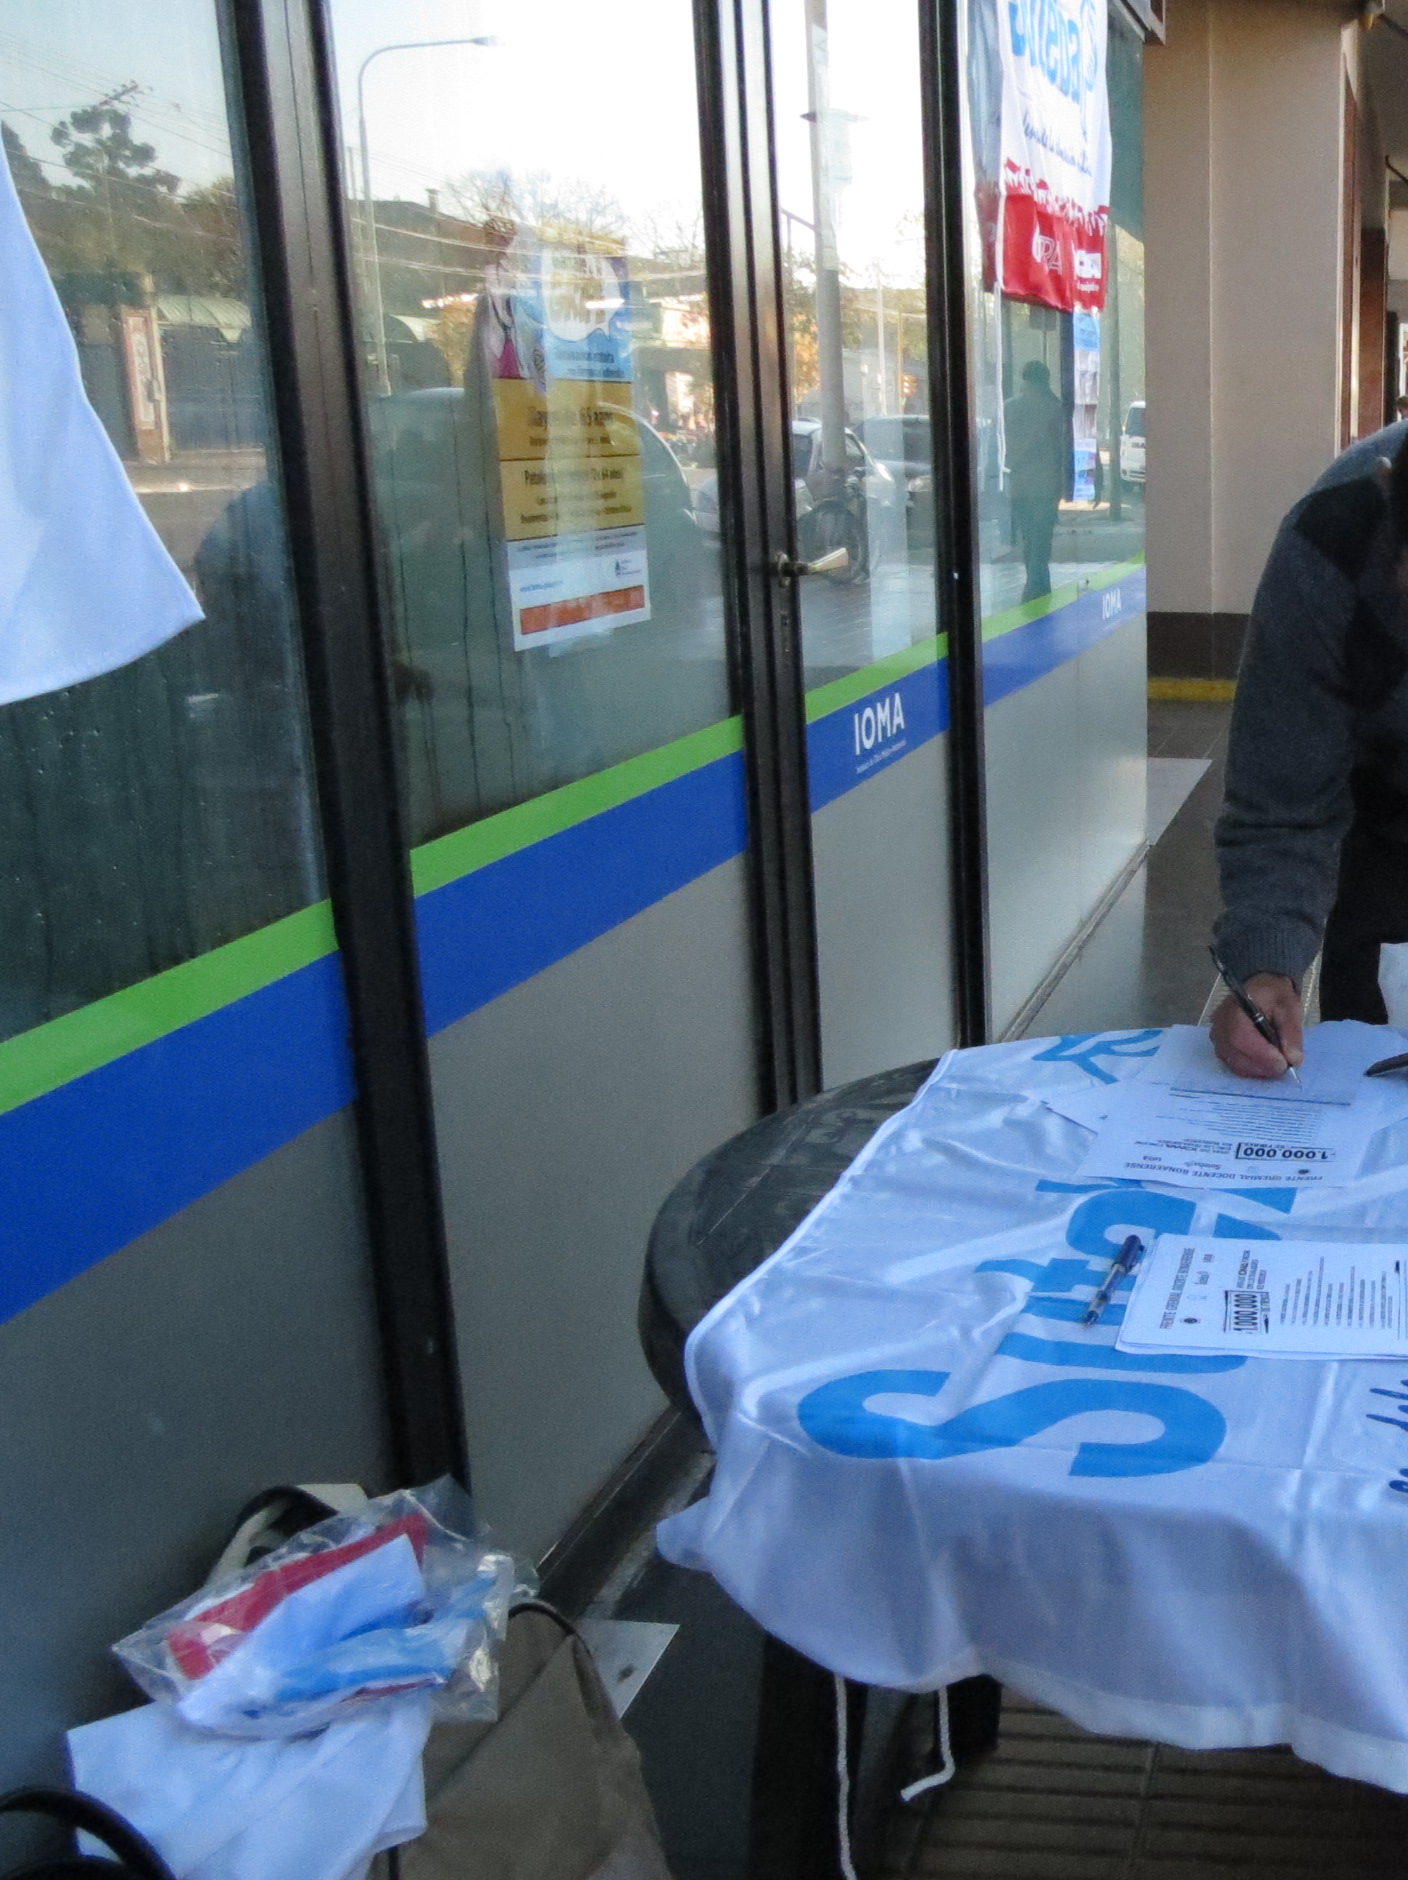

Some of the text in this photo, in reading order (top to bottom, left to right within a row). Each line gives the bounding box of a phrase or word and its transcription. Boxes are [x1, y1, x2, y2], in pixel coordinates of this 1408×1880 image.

[1102, 588, 1122, 620] IOMA
[854, 692, 905, 756] IOMA
[1243, 1147, 1329, 1160] 1.000.000
[1192, 1170, 1236, 1180] DOCENTE
[1233, 1293, 1258, 1331] 1.000.000
